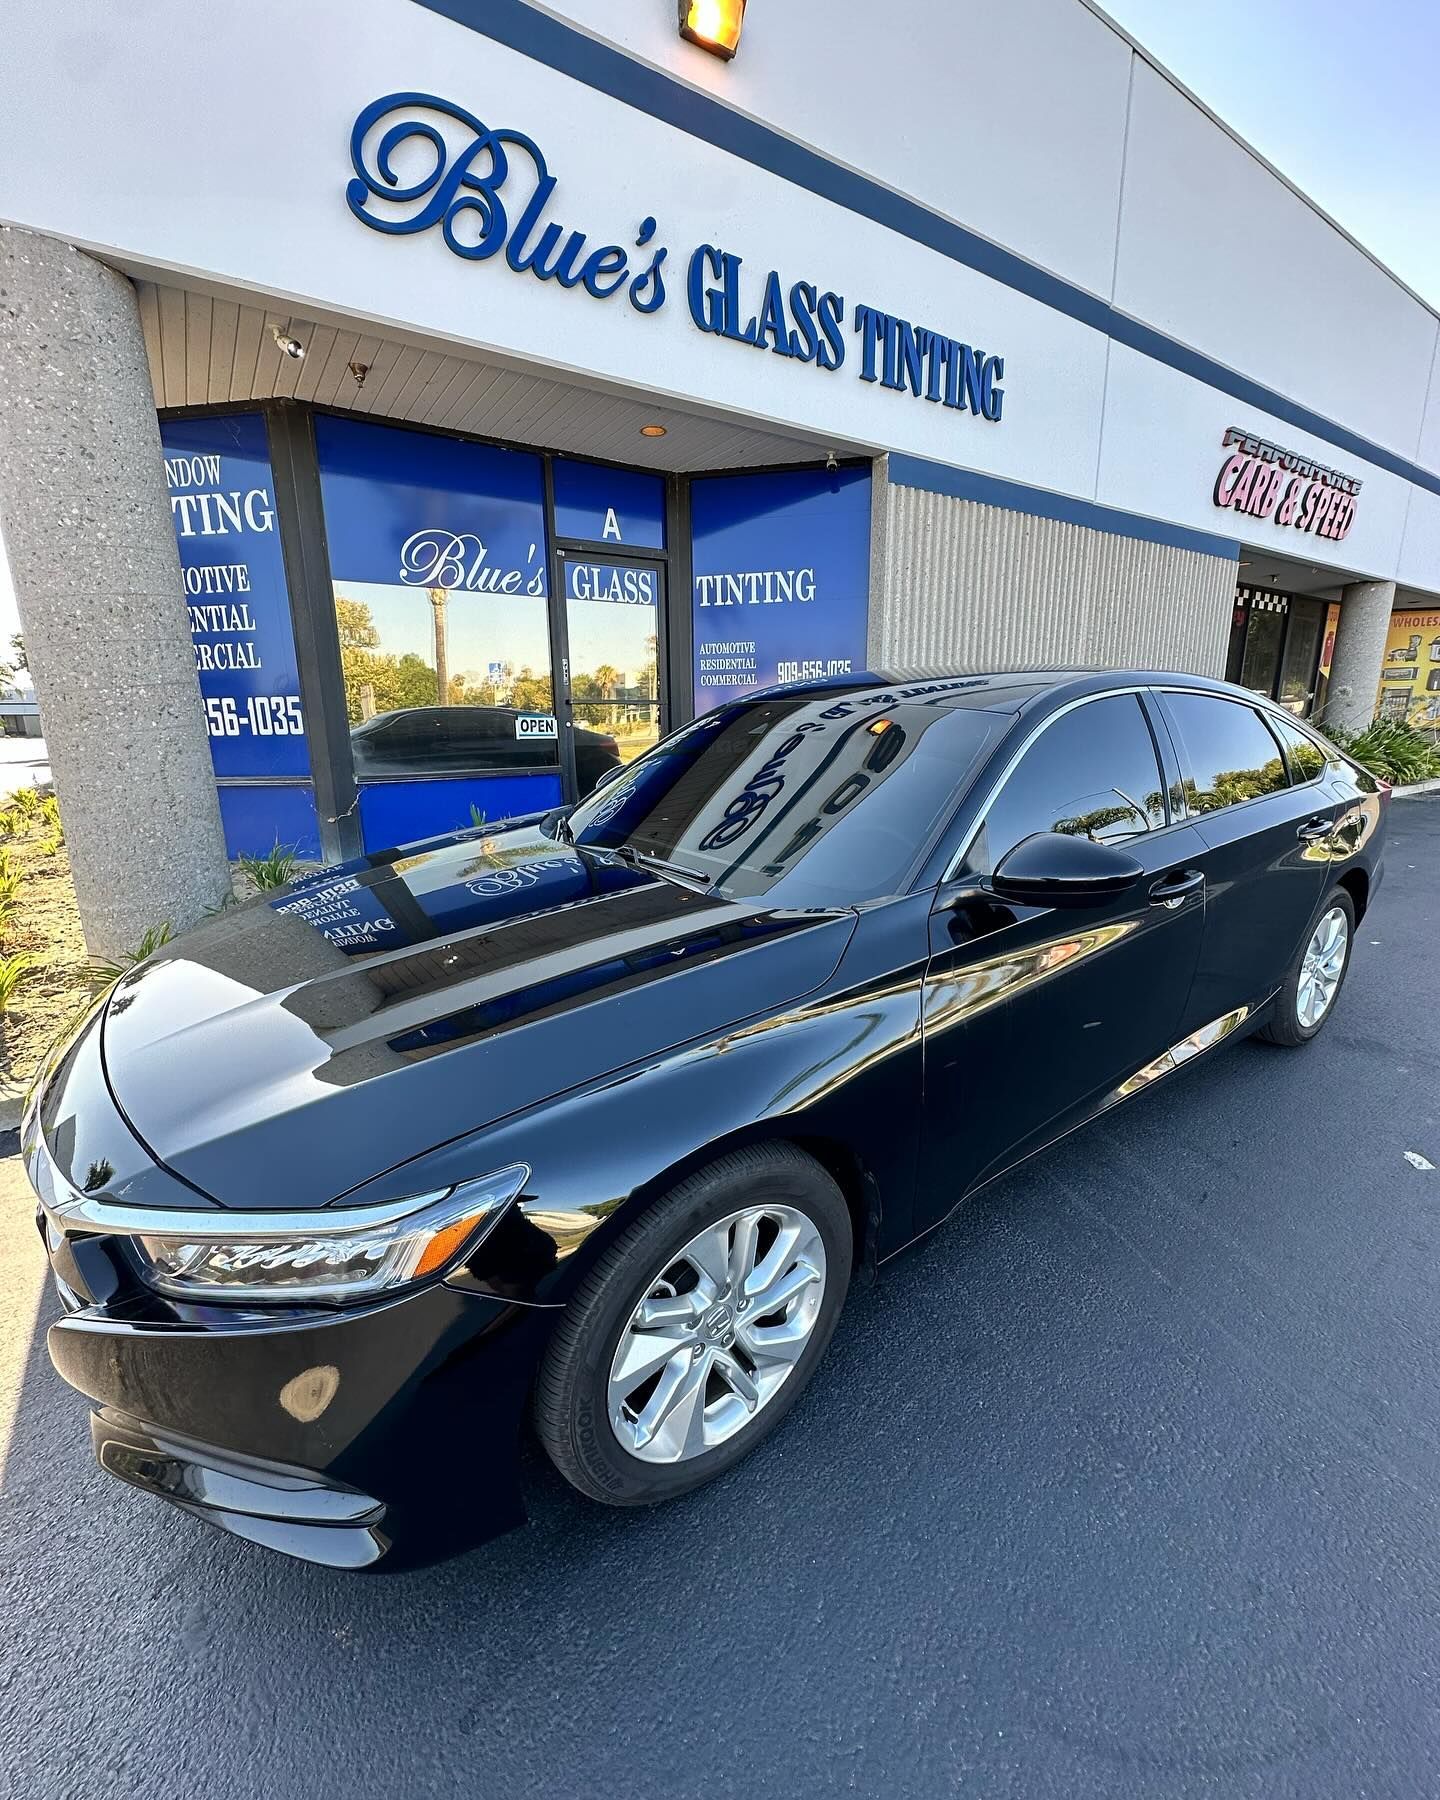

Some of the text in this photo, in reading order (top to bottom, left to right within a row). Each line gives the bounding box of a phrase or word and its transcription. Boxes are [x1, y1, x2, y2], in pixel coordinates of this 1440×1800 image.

[346, 92, 1005, 423] Blue's GLASS TINTING
[1222, 426, 1364, 497] PERFORMANCE
[171, 489, 275, 536] TING
[1213, 454, 1358, 541] CARB & SPEED
[602, 507, 622, 541] A
[399, 528, 817, 607] Blue's GLASS TINTING
[1393, 616, 1440, 628] WHOLES
[700, 641, 756, 655] AUTOMOTIVE
[700, 657, 757, 670] RESIDENTIAL
[701, 673, 758, 686] COMMERCIAL
[777, 659, 852, 685] 909-656-1035
[202, 696, 305, 737] 56-1035
[520, 718, 554, 733] OPEN
